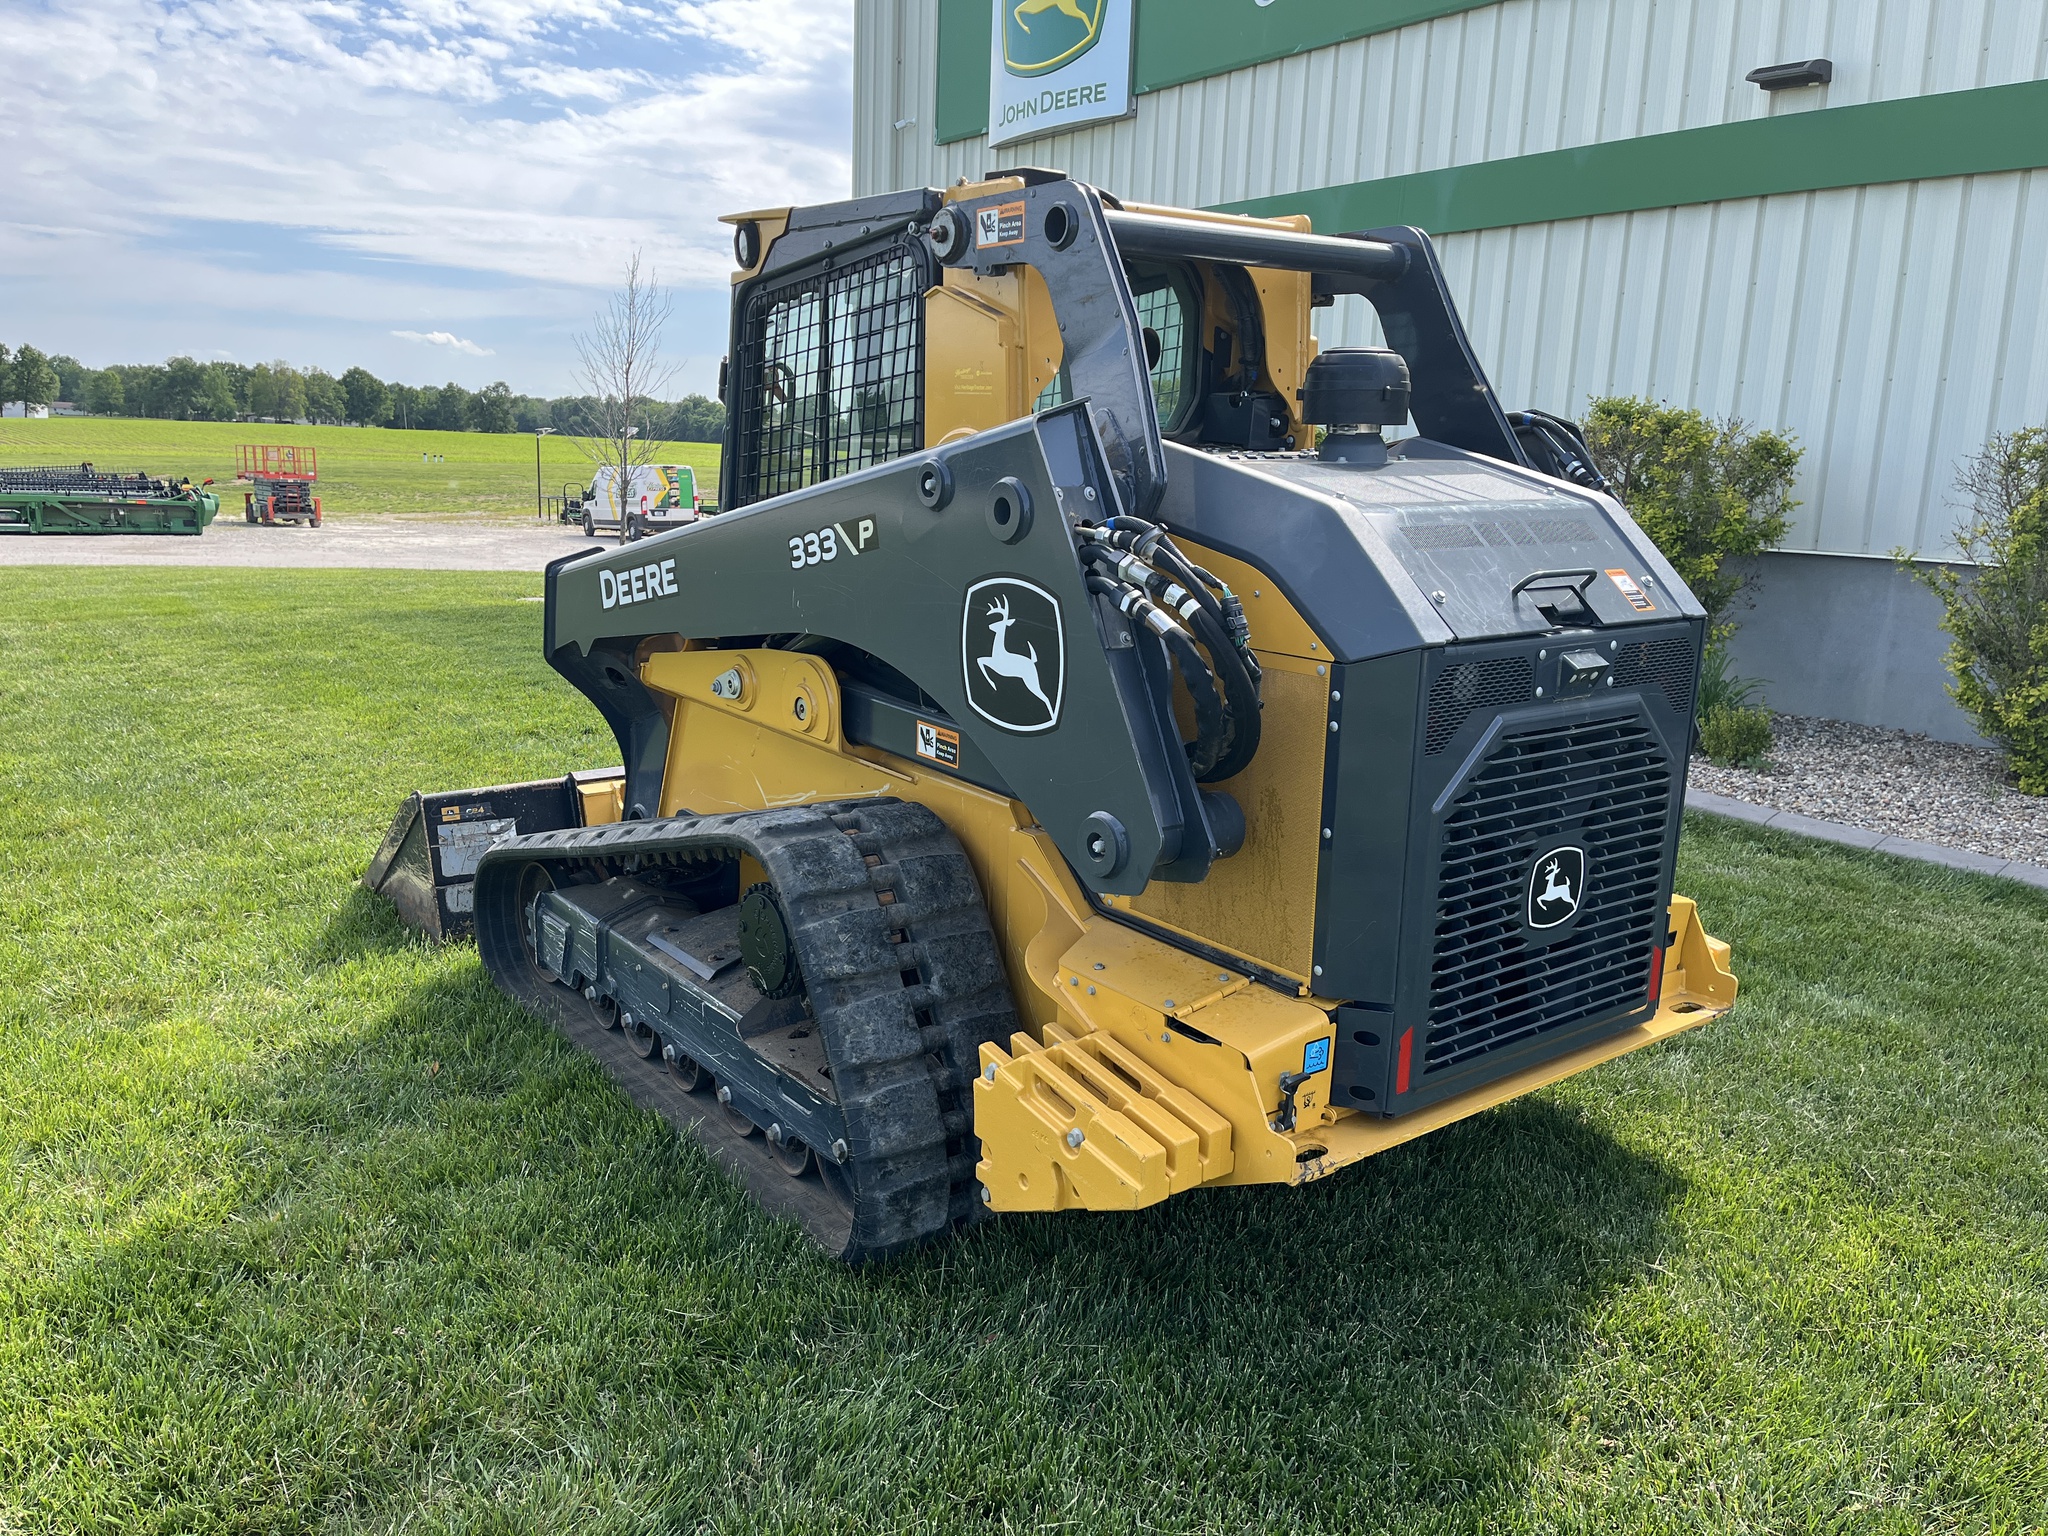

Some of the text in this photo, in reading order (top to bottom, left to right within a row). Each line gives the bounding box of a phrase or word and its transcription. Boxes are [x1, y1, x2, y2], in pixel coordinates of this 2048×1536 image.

[998, 82, 1107, 128] JOHN DEERE
[1004, 205, 1023, 214] WARNING
[999, 220, 1022, 230] Pinch Area
[1008, 229, 1019, 237] Away
[789, 527, 838, 569] 333
[599, 558, 679, 610] DEERE
[936, 742, 956, 754] Pinch Area
